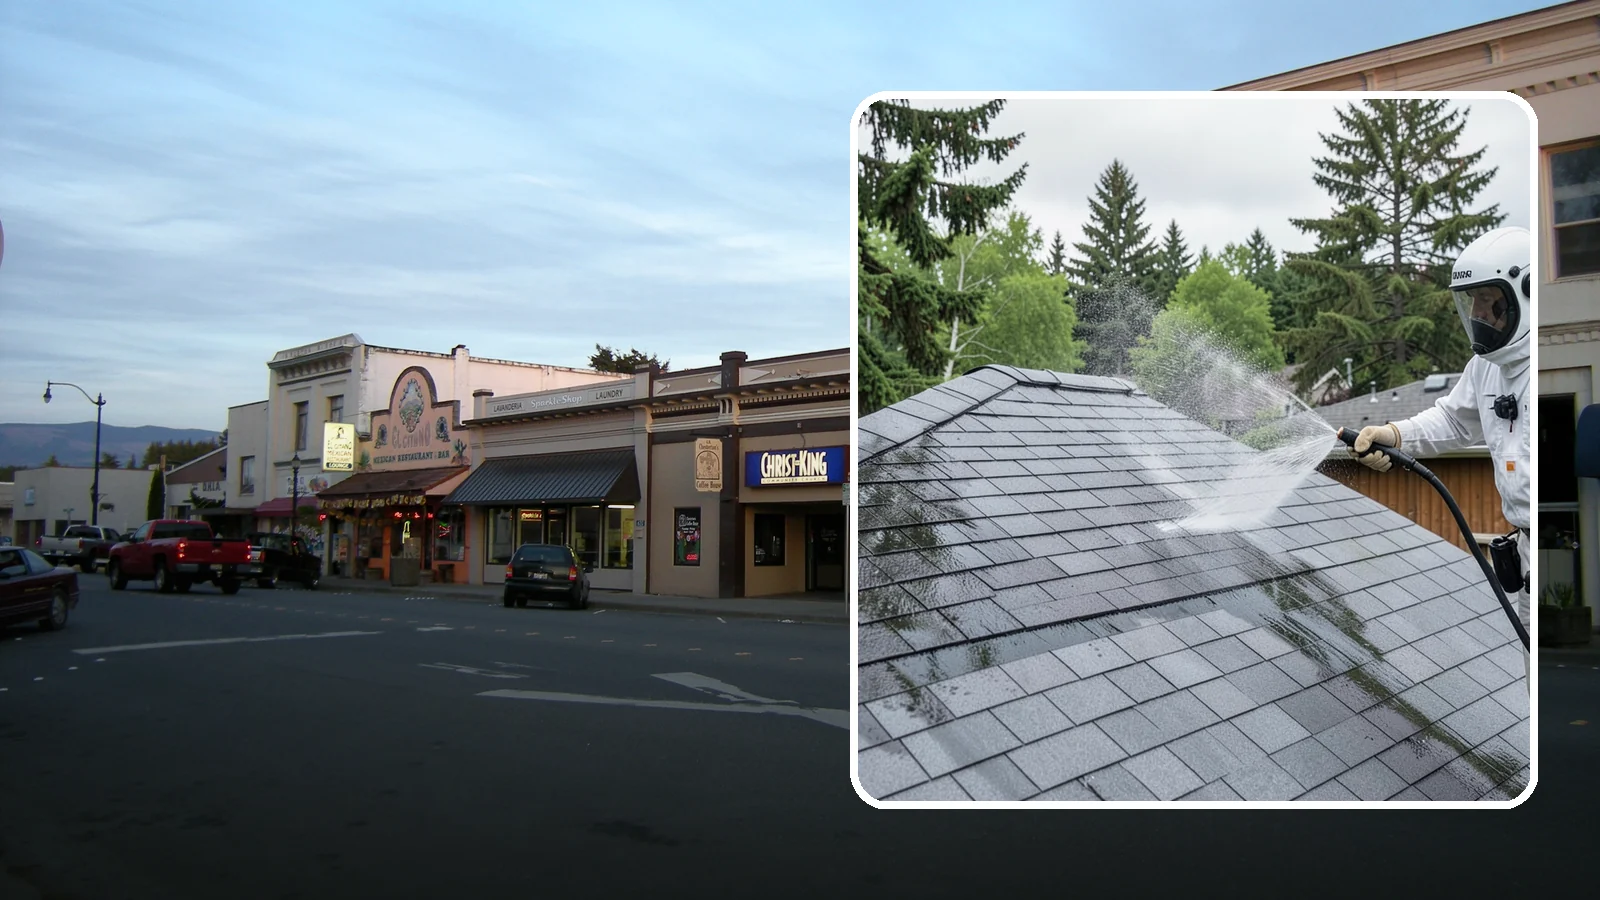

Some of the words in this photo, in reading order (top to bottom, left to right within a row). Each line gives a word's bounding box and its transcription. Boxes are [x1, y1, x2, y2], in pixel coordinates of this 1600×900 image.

[595, 388, 623, 400] LAUNDRY
[493, 402, 522, 413] LAVANDERIA
[530, 397, 559, 409] Sparkle
[560, 395, 583, 405] Shop
[373, 454, 396, 464] MEXICAN
[398, 451, 433, 462] RESTAURANT
[437, 450, 450, 459] BAR
[760, 452, 797, 478] CHRIST
[799, 450, 827, 477] KING
